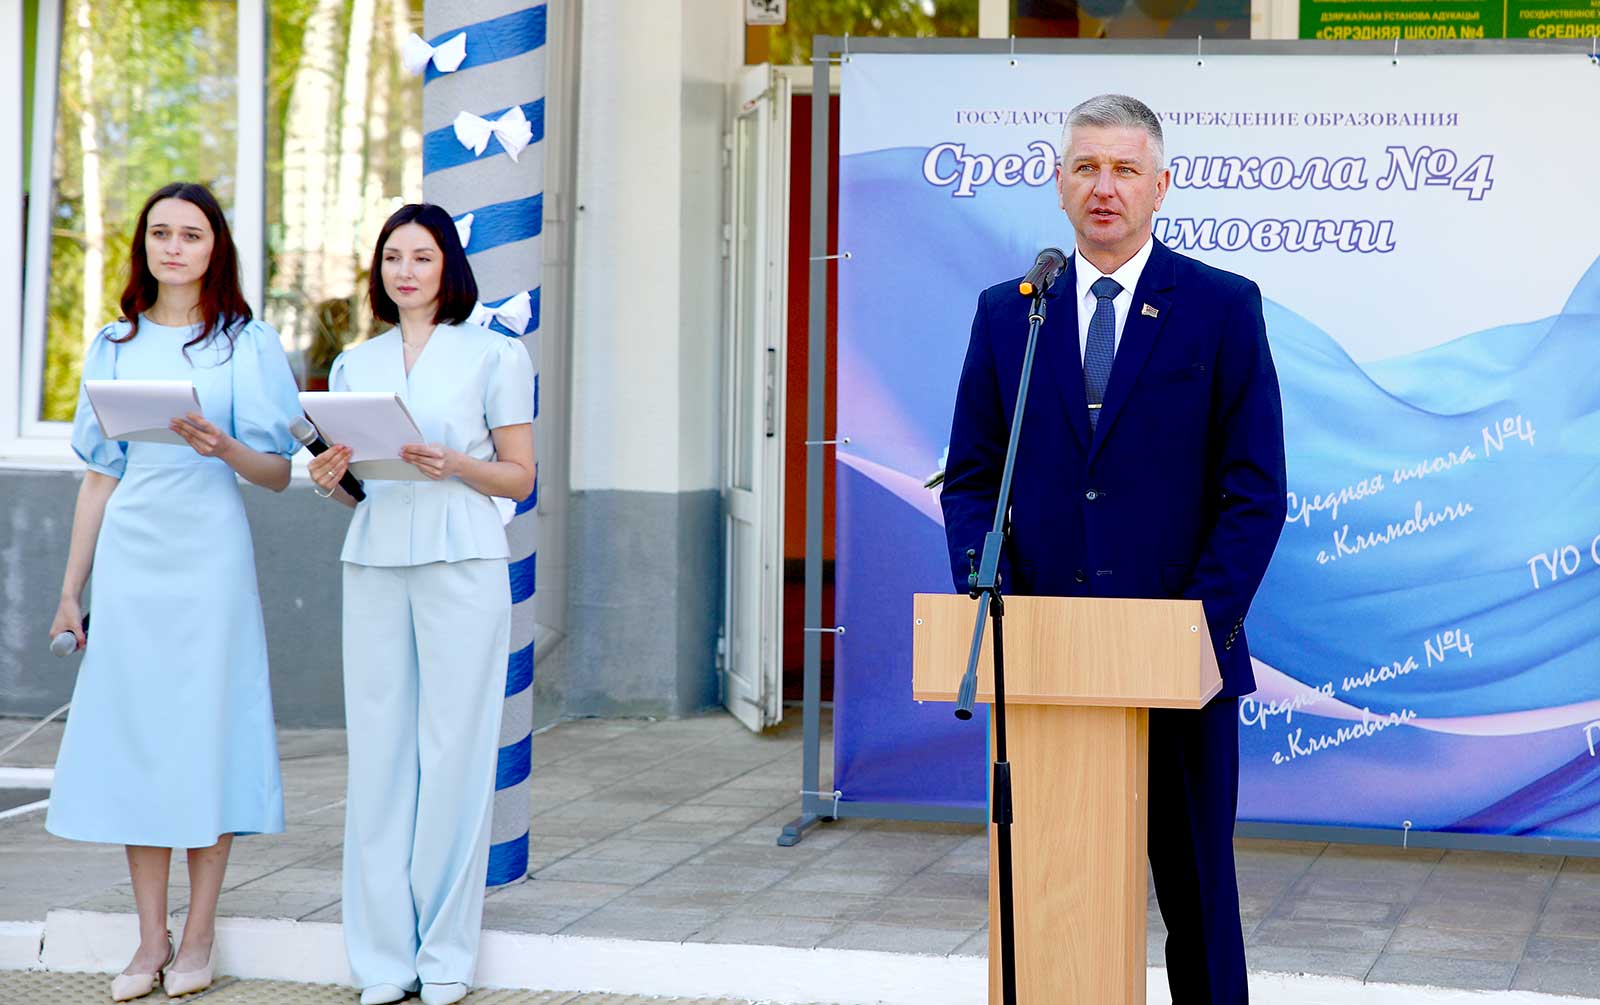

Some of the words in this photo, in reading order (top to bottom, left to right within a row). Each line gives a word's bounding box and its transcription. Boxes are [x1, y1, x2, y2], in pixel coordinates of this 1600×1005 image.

[1316, 26, 1400, 40] «СЯРЭДНЯЯ
[1404, 26, 1457, 40] ШКОЛА
[1460, 25, 1484, 39] №4
[956, 110, 1067, 126] ГОСУДАРСТ
[1156, 111, 1299, 127] УЧРЕЖДЕНИЕ
[1303, 111, 1459, 127] ОБРАЗОВАНИЯ
[922, 140, 1060, 197] Сред
[1170, 156, 1368, 190] школа
[1376, 145, 1495, 201] №4
[1286, 473, 1385, 528] Средняя
[1391, 445, 1476, 485] школа
[1481, 415, 1536, 457] №4
[1527, 544, 1582, 590] ГУО
[1239, 681, 1336, 731] Средняя
[1341, 655, 1419, 693] школа
[1424, 628, 1475, 668] №4
